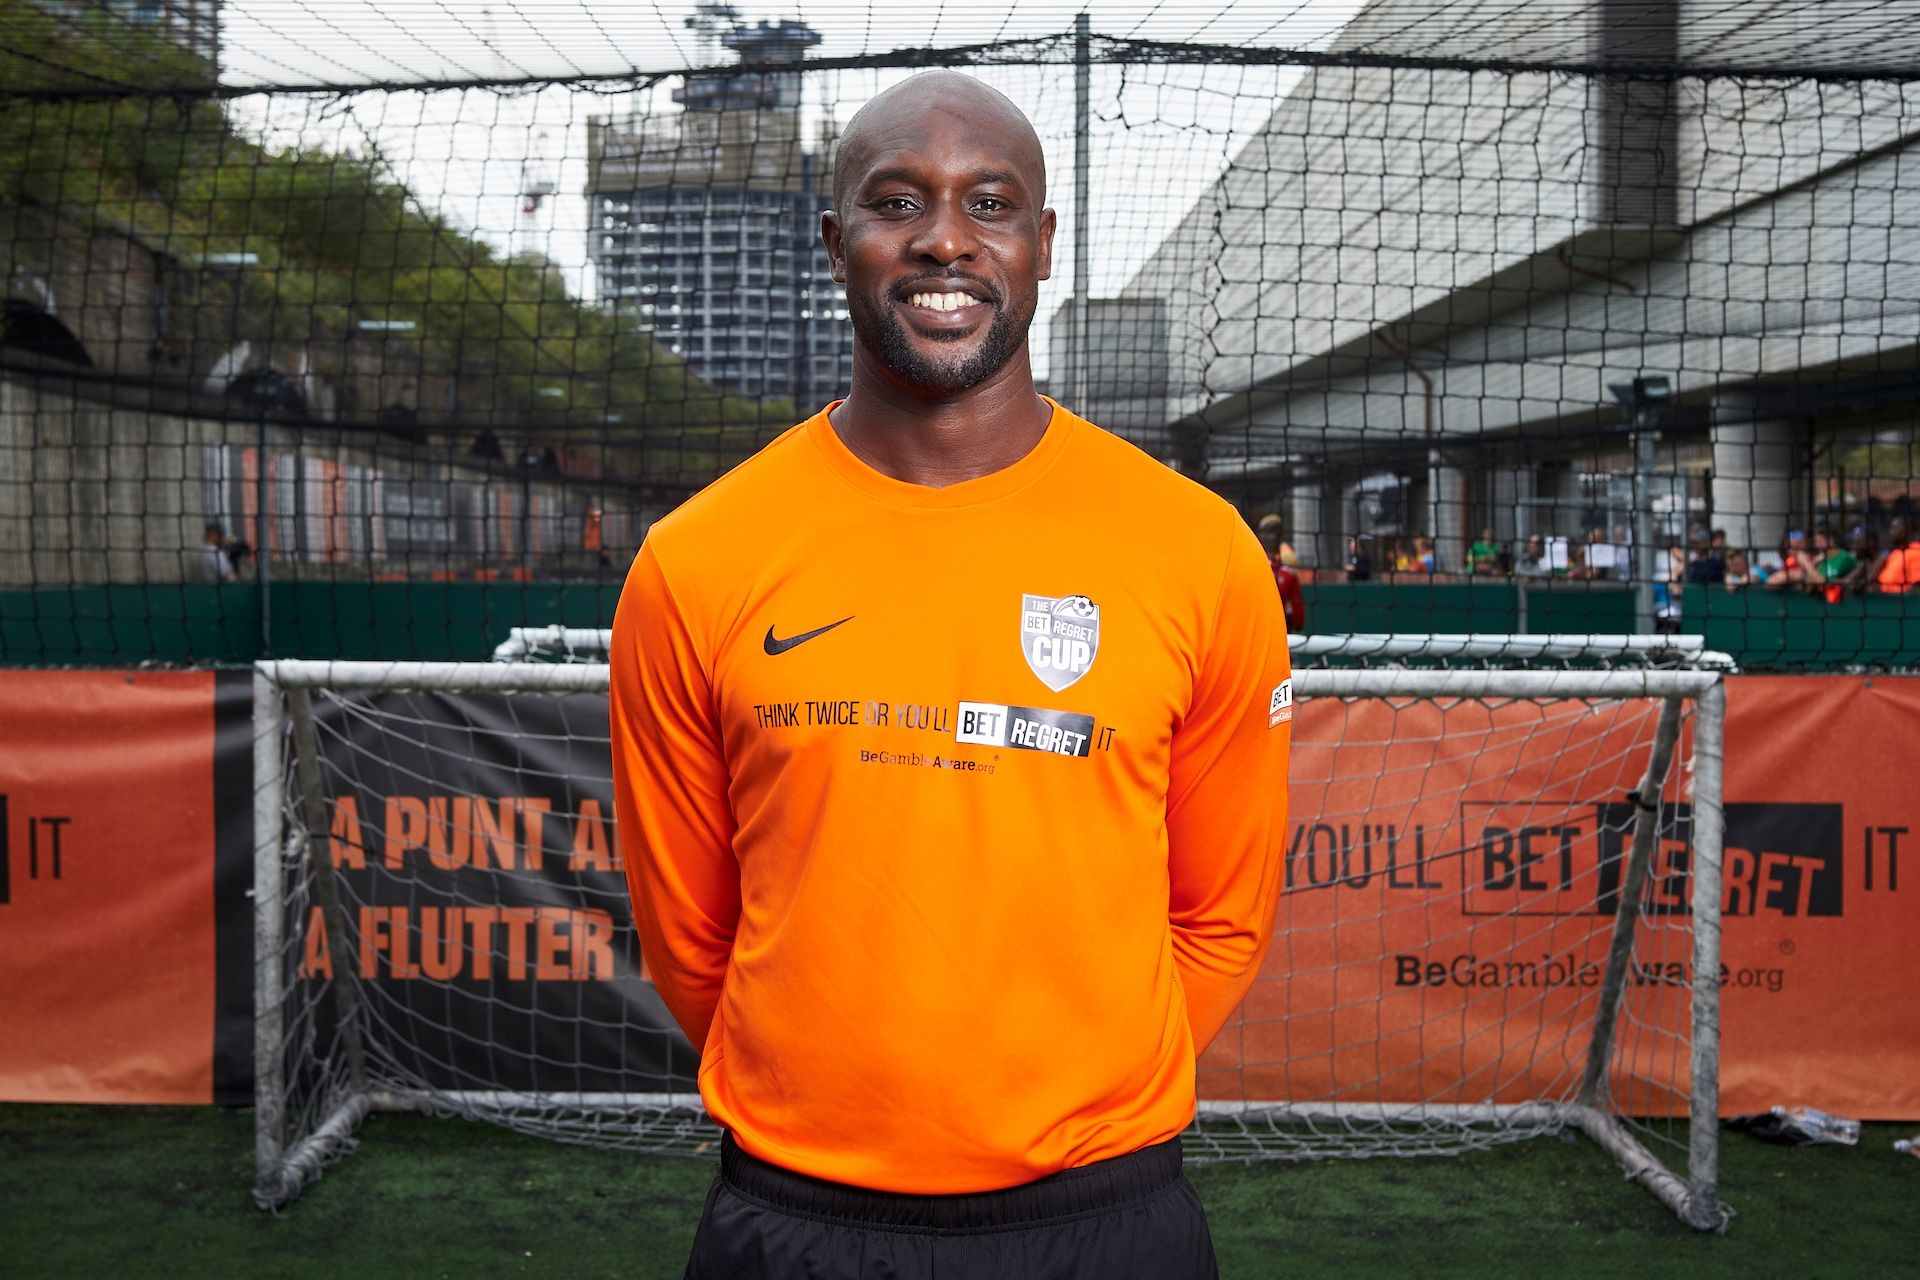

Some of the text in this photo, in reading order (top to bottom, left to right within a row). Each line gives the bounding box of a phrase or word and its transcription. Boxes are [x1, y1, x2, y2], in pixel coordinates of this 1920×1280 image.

[1027, 616, 1094, 642] BET REGRET
[1032, 600, 1049, 612] THE
[1032, 635, 1091, 673] CUP
[1273, 684, 1289, 708] BET
[753, 701, 1117, 757] THINK TWICE OR YOU'LL BET REGRET IT
[860, 749, 995, 774] BeGambleAware.org
[29, 815, 72, 880] IT
[330, 795, 367, 870] A
[384, 795, 553, 871] PUNT
[1483, 826, 1581, 892] BET
[1865, 826, 1909, 892] IT
[300, 904, 334, 980] A
[359, 905, 615, 982] FLUTTER
